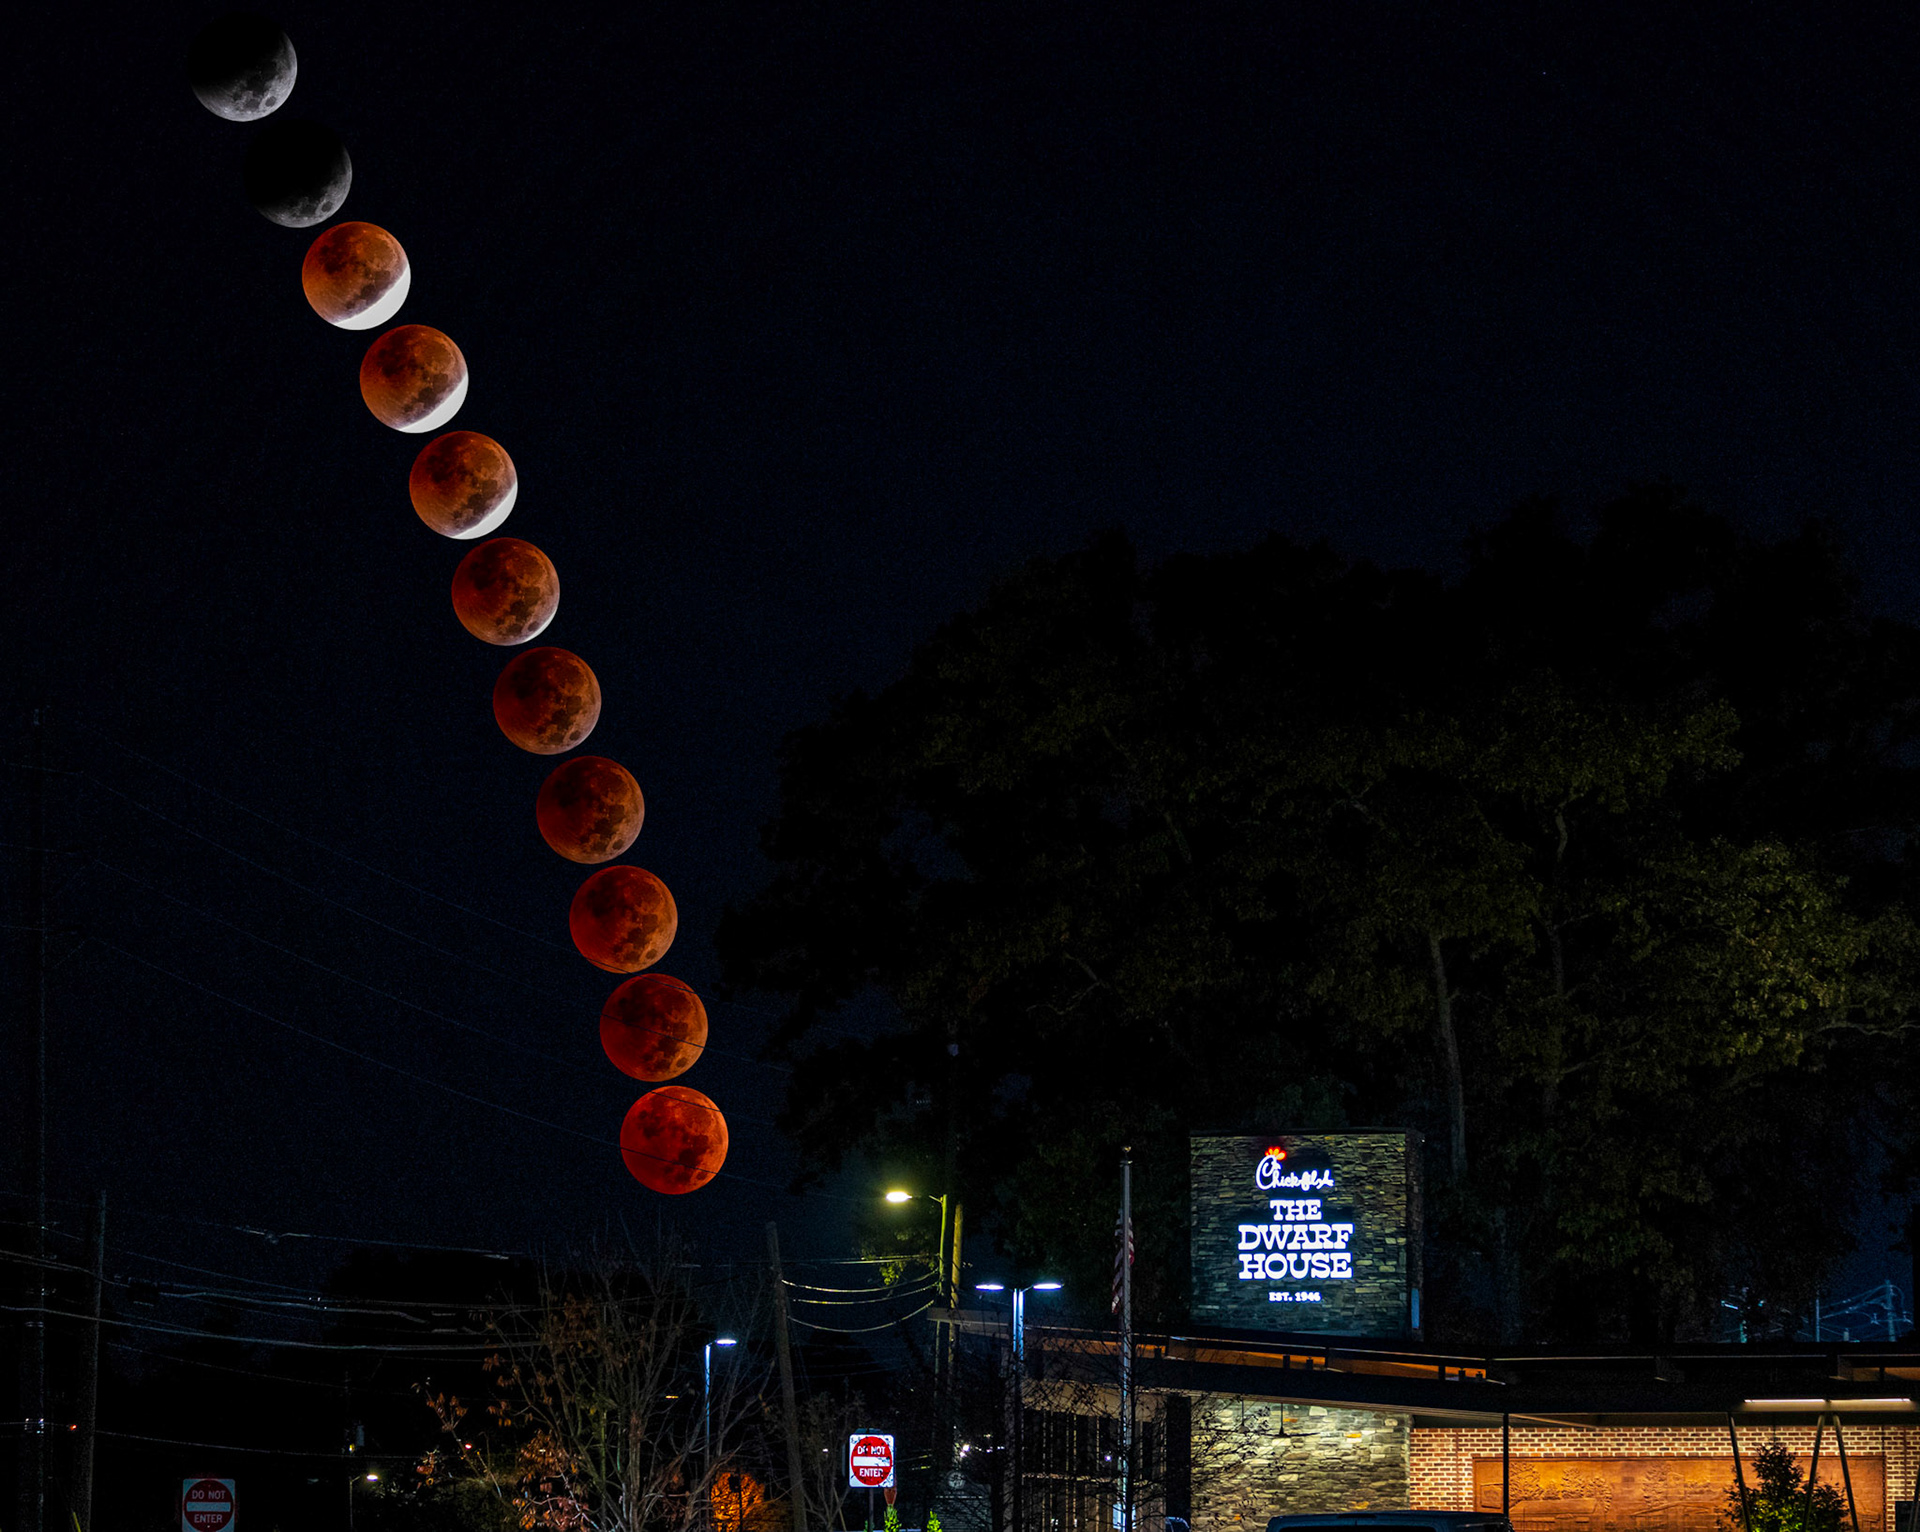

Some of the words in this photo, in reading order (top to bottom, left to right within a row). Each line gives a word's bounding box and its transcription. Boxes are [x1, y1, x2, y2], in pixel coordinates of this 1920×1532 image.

[1270, 1199, 1322, 1221] THE
[1238, 1224, 1354, 1250] DWARF
[1238, 1252, 1353, 1280] HOUSE
[1268, 1291, 1293, 1302] EST.
[1295, 1291, 1321, 1302] 1946
[871, 1446, 886, 1455] NOT
[859, 1468, 884, 1477] ENTER
[192, 1490, 205, 1499] DO
[208, 1490, 226, 1499] NOT
[194, 1514, 223, 1523] ENTER
